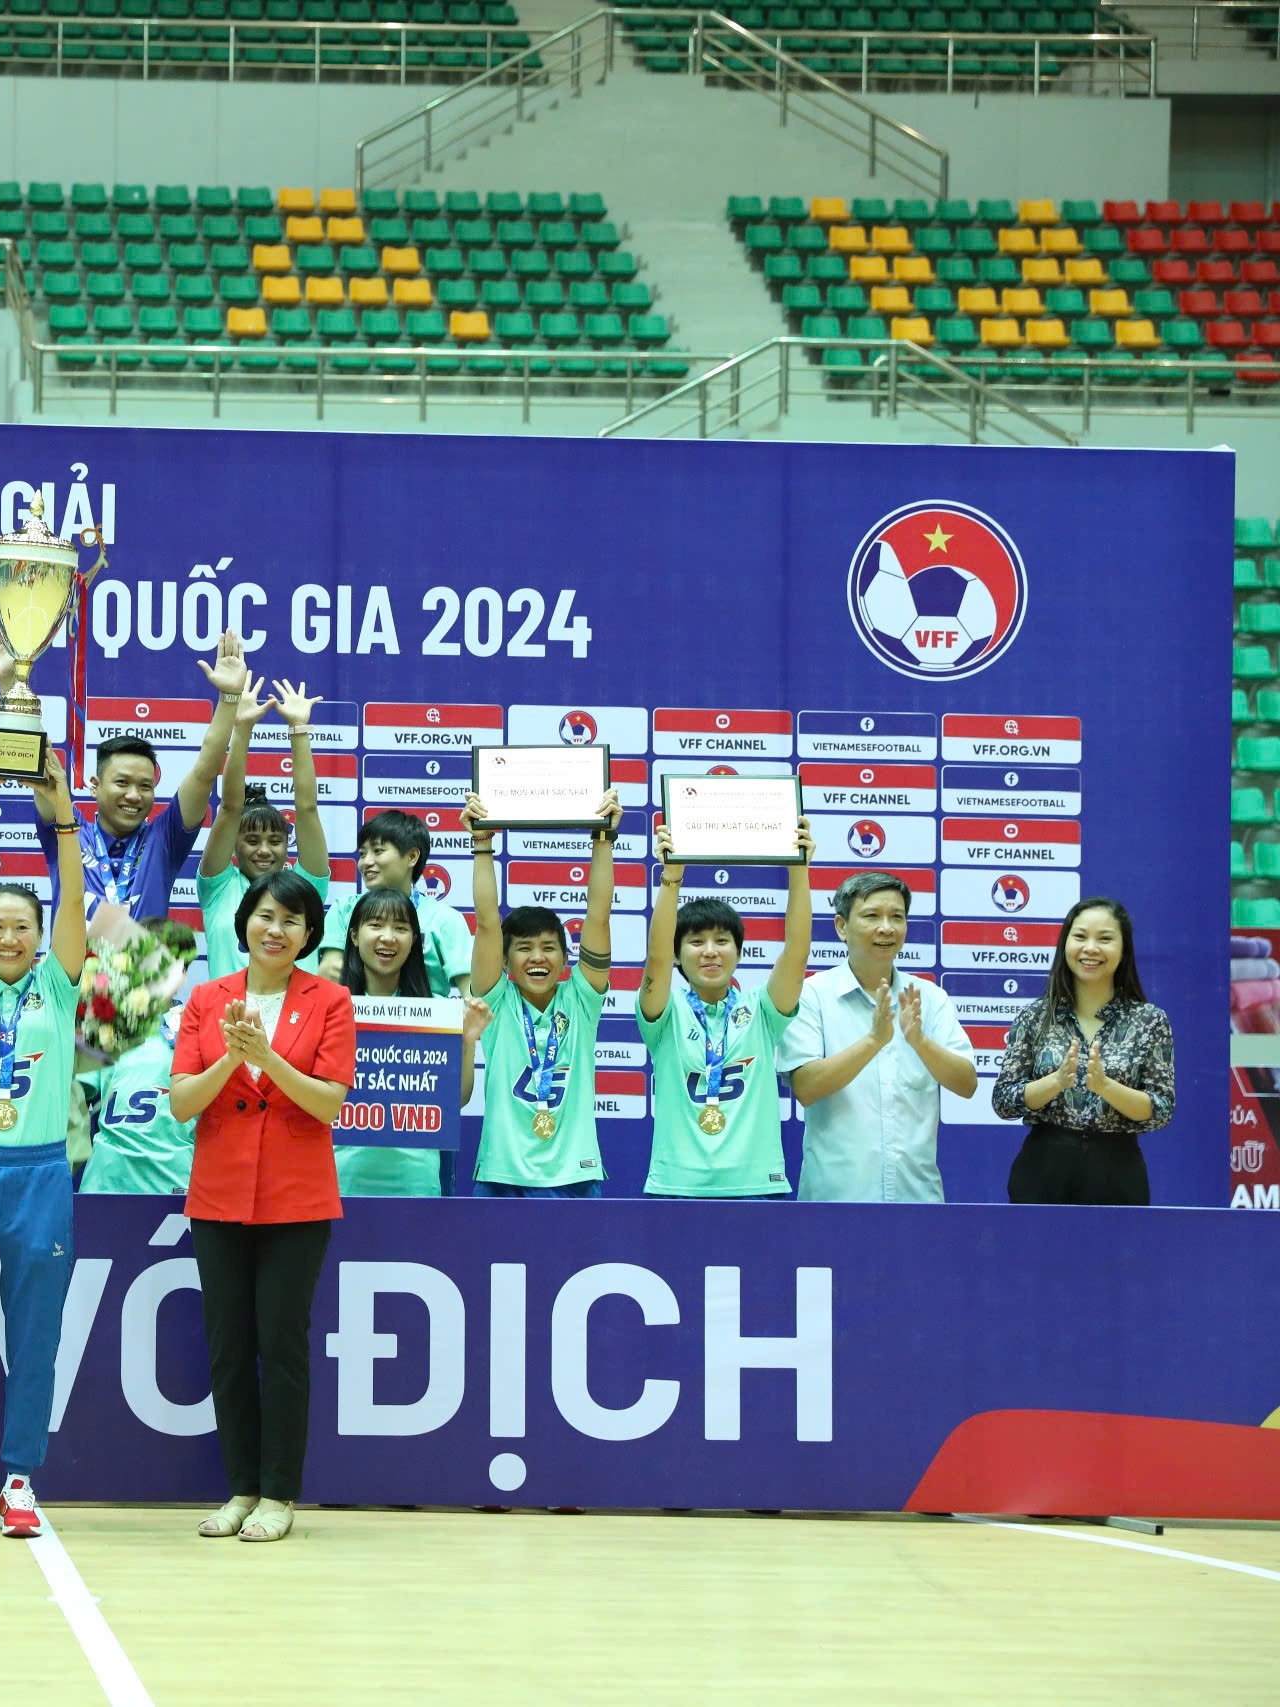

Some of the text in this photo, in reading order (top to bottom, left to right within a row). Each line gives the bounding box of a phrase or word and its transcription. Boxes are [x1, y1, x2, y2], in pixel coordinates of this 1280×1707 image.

[0, 462, 116, 545] GIẢI
[91, 557, 268, 654] QUỐC
[290, 582, 401, 655] GIA
[422, 586, 592, 658] 2024
[915, 630, 959, 648] VFF
[98, 727, 187, 740] VFF CHANNEL
[394, 732, 472, 745] VFF.ORG.VN
[679, 738, 767, 751] VFF CHANNEL
[812, 742, 922, 753] VIETNAMESEFOOTBALL
[972, 744, 1051, 757] VFF.ORG.VN
[823, 793, 911, 805] VFF CHANNEL
[956, 796, 1066, 808] VIETNAMESEFOOTBALL
[430, 837, 475, 849] HANNEL
[967, 847, 1055, 860] VFF CHANNEL
[533, 891, 556, 902] VFF
[972, 951, 1050, 964] VFF.ORG.VN
[372, 1003, 432, 1020] ĐÁ VIỆT NAM
[7, 1029, 15, 1046] VFF
[688, 1029, 700, 1041] 10
[371, 1043, 448, 1065] QUỐC GIA 2024
[548, 1045, 557, 1061] VFF
[367, 1067, 397, 1091] SẮC
[398, 1067, 439, 1092] NHẤT
[512, 1065, 568, 1109] LS
[686, 1065, 746, 1104] LS
[104, 1090, 160, 1125] LS
[391, 1103, 442, 1132] VNĐ
[326, 1261, 833, 1491] ĐỊCH
